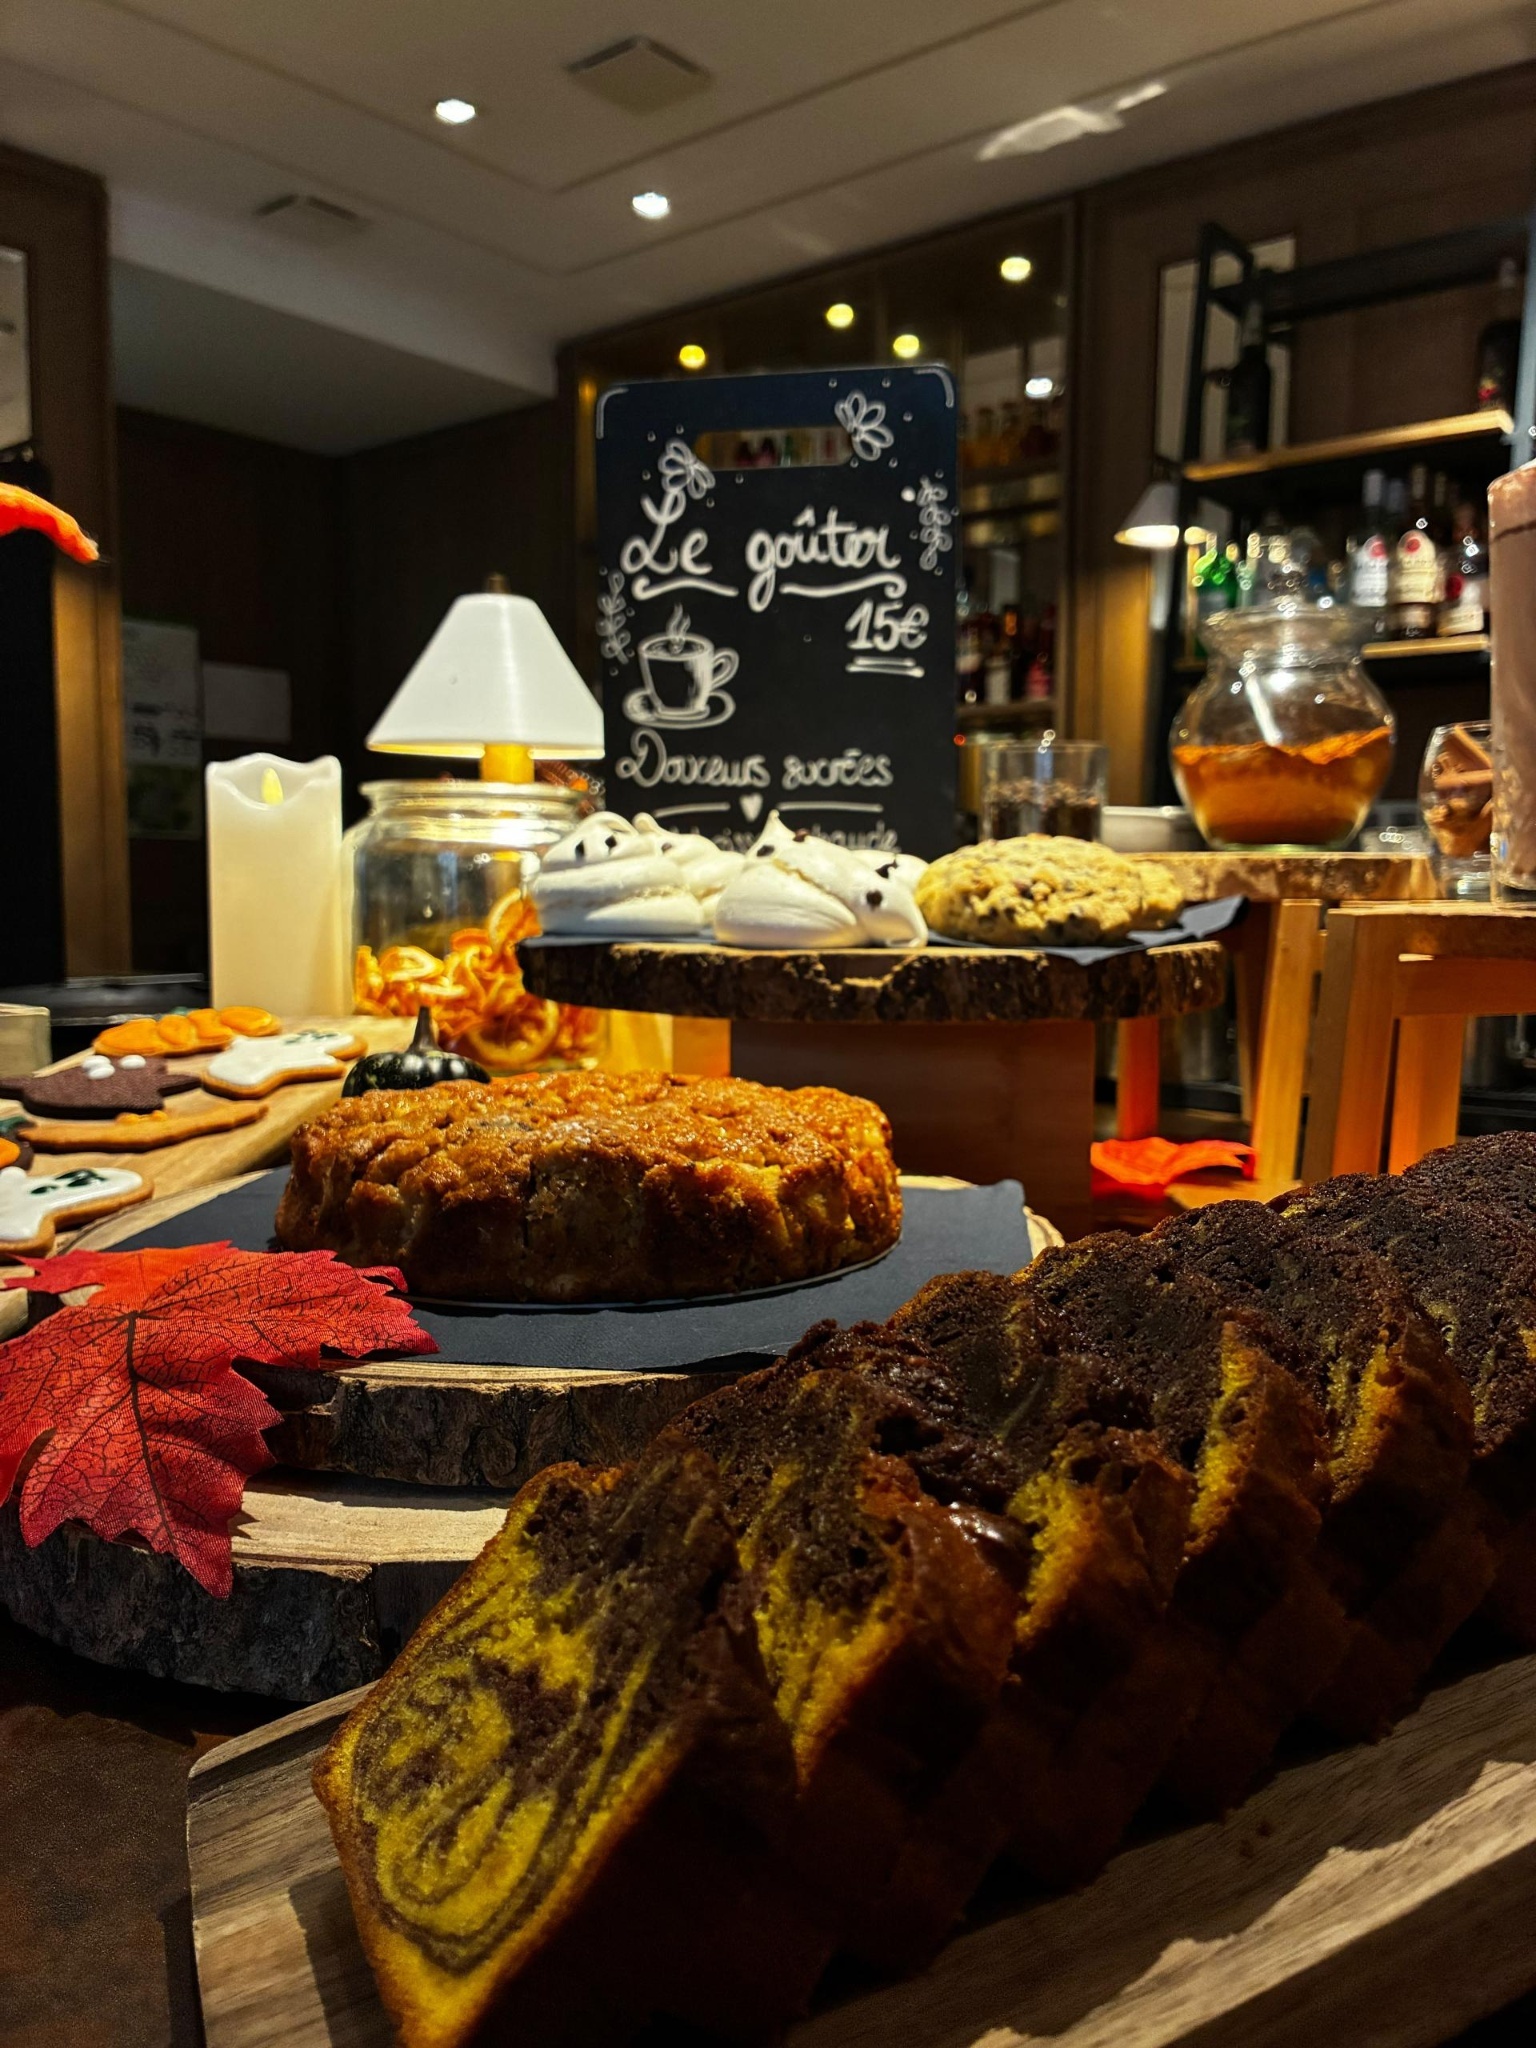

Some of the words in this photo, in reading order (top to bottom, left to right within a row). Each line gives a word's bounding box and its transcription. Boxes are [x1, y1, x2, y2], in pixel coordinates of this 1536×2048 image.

[621, 494, 712, 574] Le
[745, 505, 901, 611] goûter
[844, 599, 929, 650] 15€
[782, 748, 894, 790] sucrées
